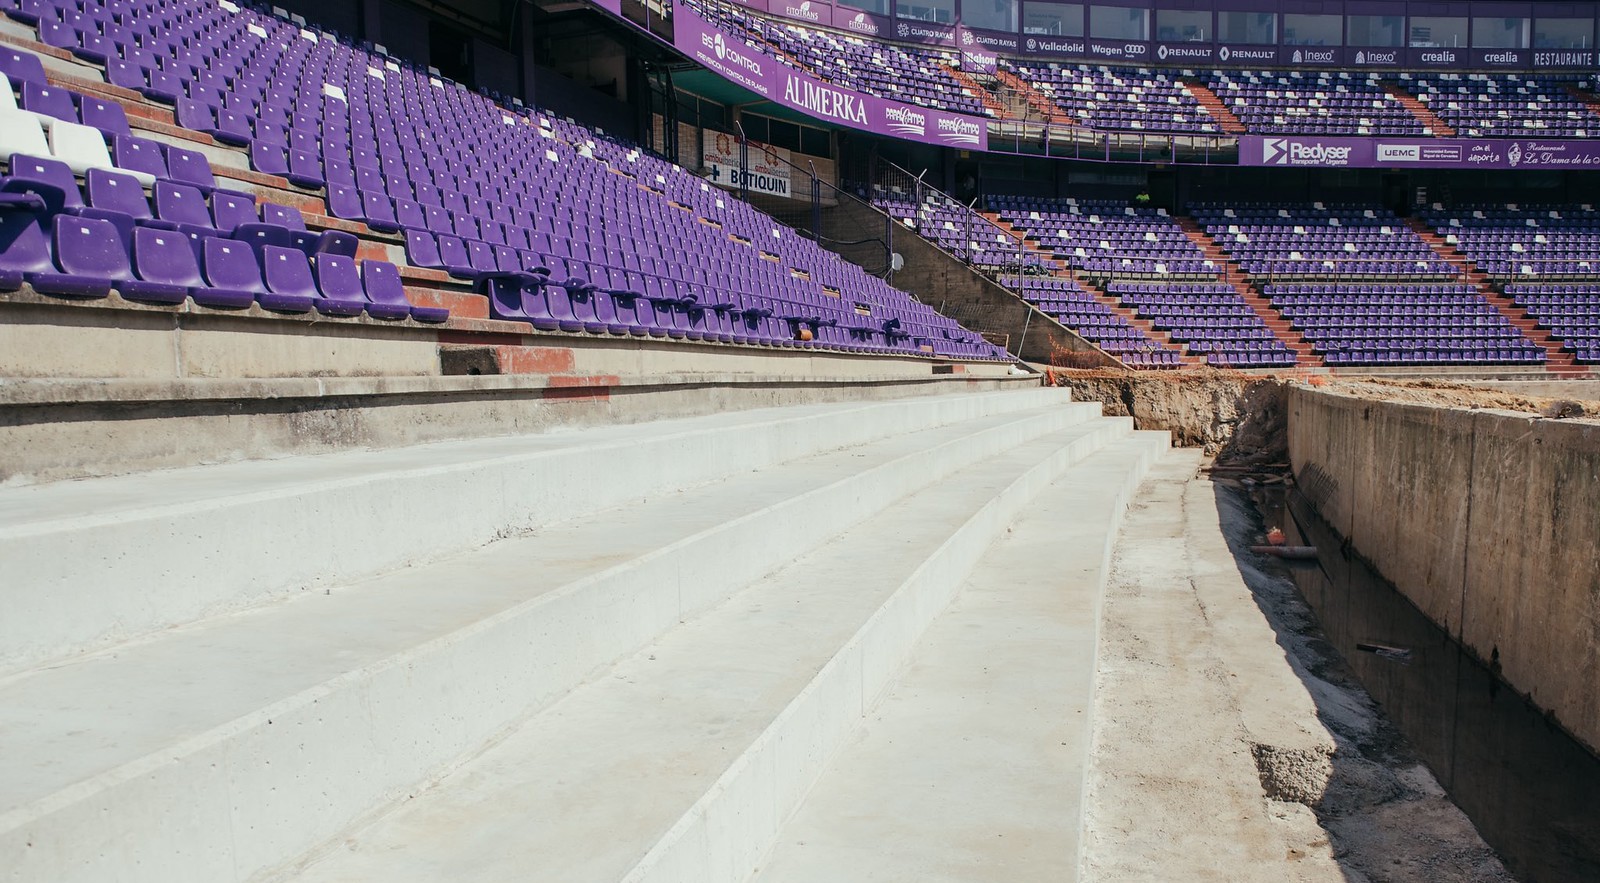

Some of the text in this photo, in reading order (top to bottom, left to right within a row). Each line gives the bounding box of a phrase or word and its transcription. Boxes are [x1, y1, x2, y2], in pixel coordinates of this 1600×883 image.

[786, 6, 819, 20] FITOTRANS
[848, 20, 879, 33] FITOTRANS
[910, 28, 954, 40] CUATRO RAYAS
[976, 36, 1017, 48] CUATRO RAYAS
[1039, 41, 1085, 53] Valladolid
[1091, 44, 1122, 55] Wagen
[701, 32, 763, 77] BS CONTROL
[1168, 48, 1212, 57] RENAULT
[1232, 50, 1275, 59] RENAULT
[1304, 49, 1333, 61] Inexo
[1367, 51, 1395, 62] Inexo
[1421, 51, 1456, 62] crealia
[1484, 51, 1518, 63] crealia
[1534, 52, 1592, 66] RESTAURANTE
[784, 74, 868, 126] ALIMERKA
[1290, 142, 1351, 162] Redyser
[1484, 144, 1490, 152] el
[1526, 142, 1566, 151] Restaurante
[1384, 149, 1415, 157] UEMC
[1468, 152, 1500, 165] deporte
[1523, 152, 1539, 164] La
[1540, 152, 1570, 164] Dama
[1571, 155, 1581, 164] de
[1582, 154, 1592, 164] la
[1290, 158, 1320, 166] Transporte
[730, 169, 787, 194] BOTIQUIN
